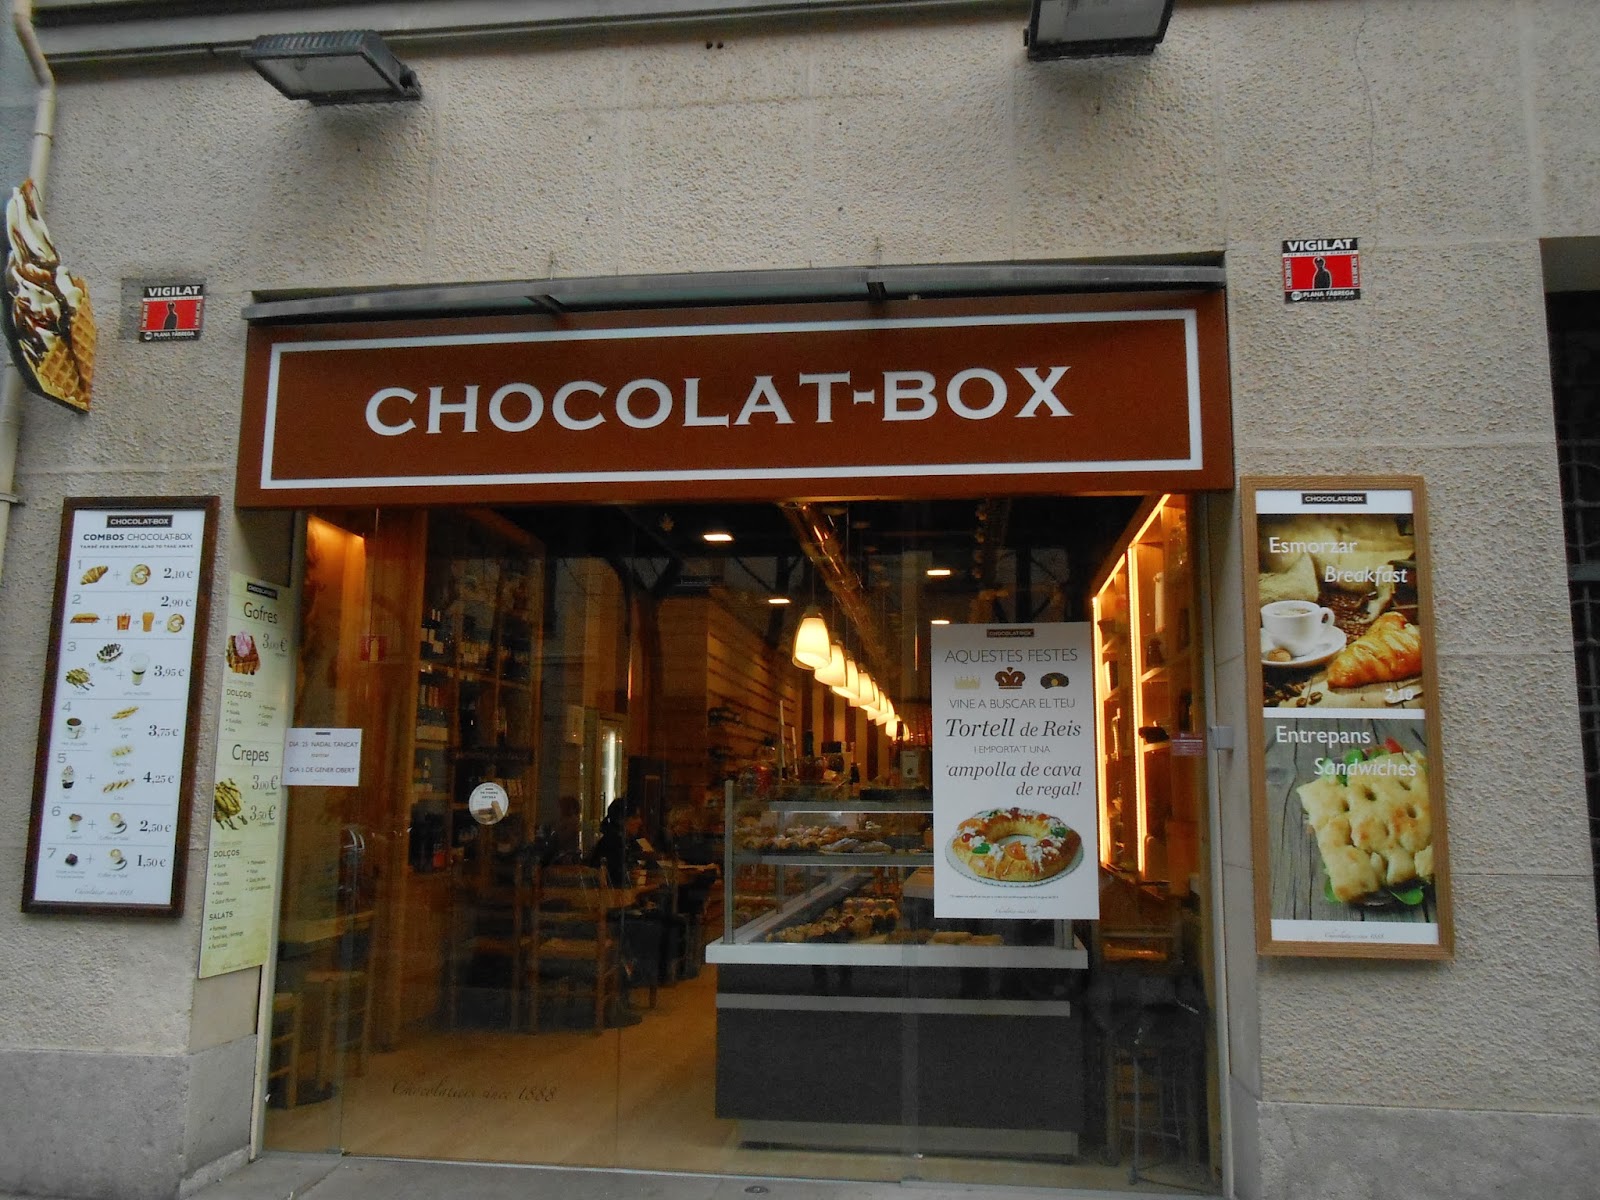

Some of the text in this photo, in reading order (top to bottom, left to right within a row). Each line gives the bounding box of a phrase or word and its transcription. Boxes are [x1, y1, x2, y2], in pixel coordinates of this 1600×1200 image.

[1287, 239, 1353, 252] VIGILAT
[148, 285, 200, 297] VIGILAT
[365, 365, 1074, 437] CHOCOLAT-BOX
[83, 533, 193, 541] COMBOS CHOCOLAT-BOX
[1268, 536, 1358, 554] Esmorzar
[1324, 565, 1408, 587] Breakfast
[71, 594, 82, 605] 2
[244, 602, 278, 624] Gofres
[66, 641, 77, 652] 3
[944, 648, 1078, 664] AQUESTES FESTES
[226, 689, 252, 699] DOLÇOS
[62, 702, 72, 712] 4
[949, 698, 1075, 709] VINE A BUSCAR EL TEU
[946, 718, 1081, 737] Tortell de Reis
[1275, 725, 1371, 748] Entrepans
[232, 744, 269, 766] Crepes
[1029, 745, 1051, 753] UNA
[57, 753, 67, 764] 5
[1020, 761, 1040, 777] de
[1043, 765, 1081, 777] cava
[1314, 758, 1417, 777] Sandwiches
[1016, 781, 1082, 799] de regal!
[51, 806, 61, 817] 6
[47, 847, 57, 858] 7
[213, 849, 240, 859] DOLÇOS
[209, 911, 233, 920] SALATS
